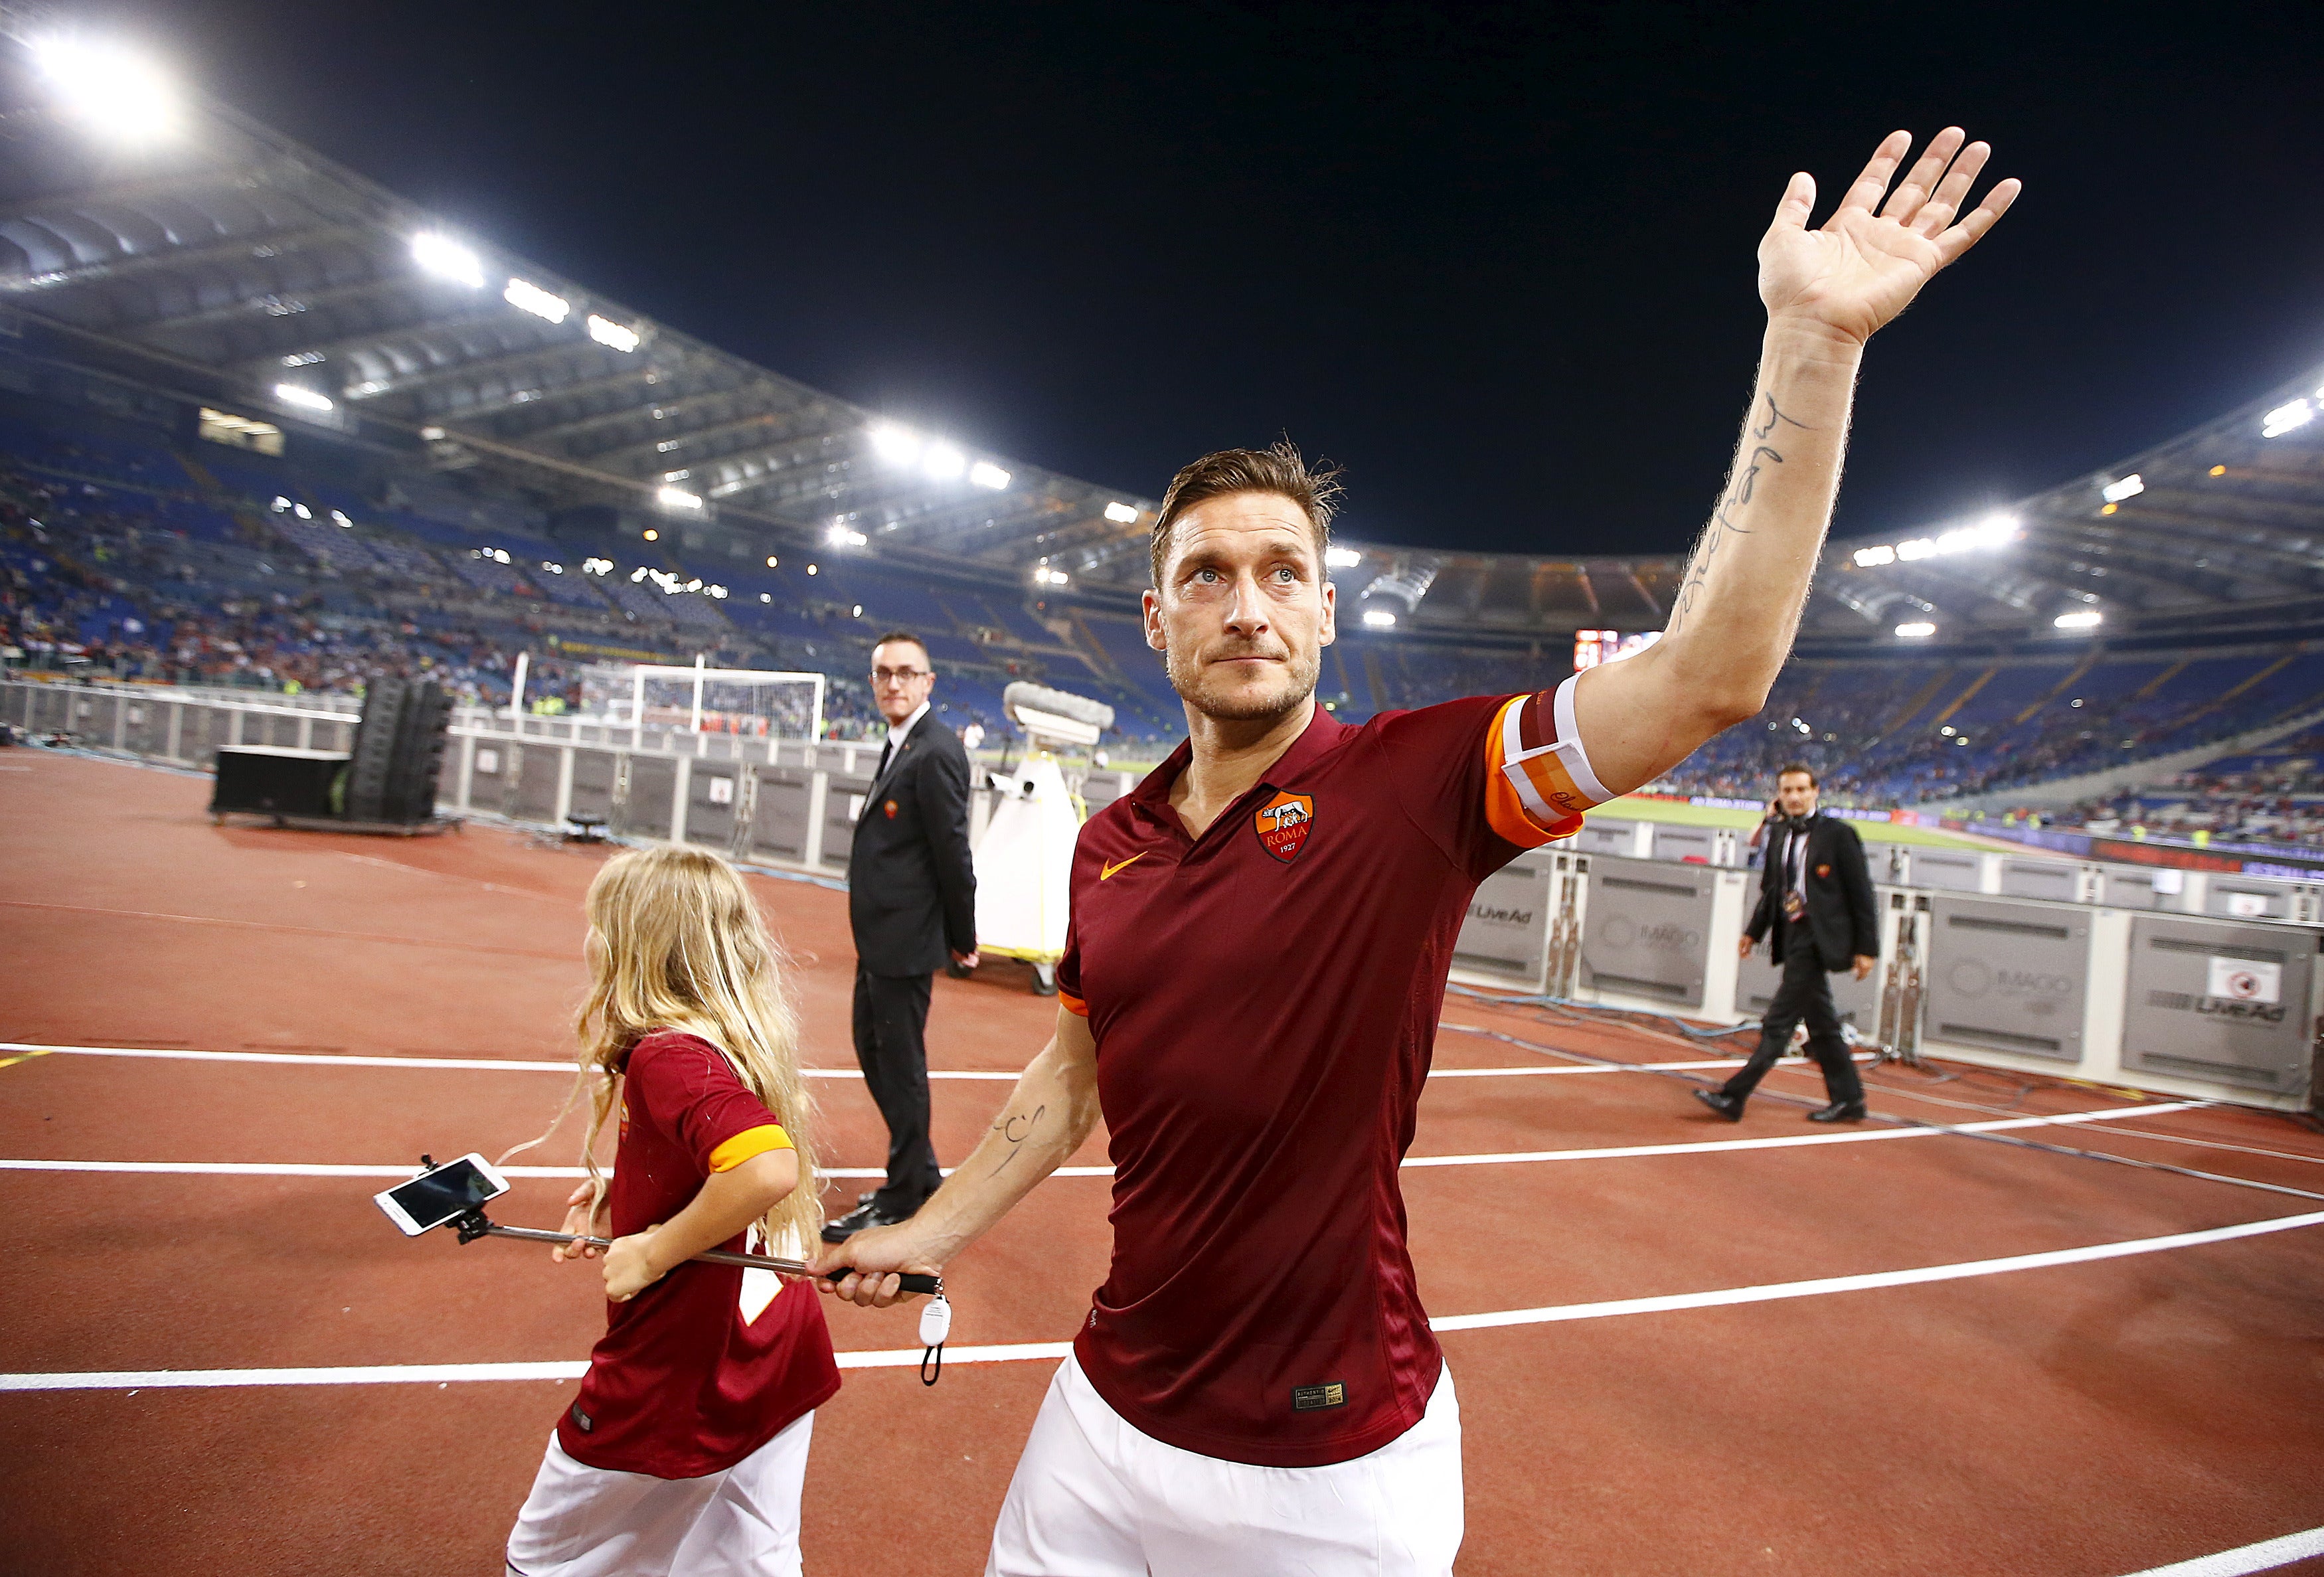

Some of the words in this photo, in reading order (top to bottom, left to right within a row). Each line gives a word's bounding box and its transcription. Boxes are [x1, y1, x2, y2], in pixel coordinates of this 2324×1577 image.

[1267, 826, 1307, 847] ROMA
[1281, 843, 1295, 853] 1927
[1476, 904, 1533, 924] LiveAd
